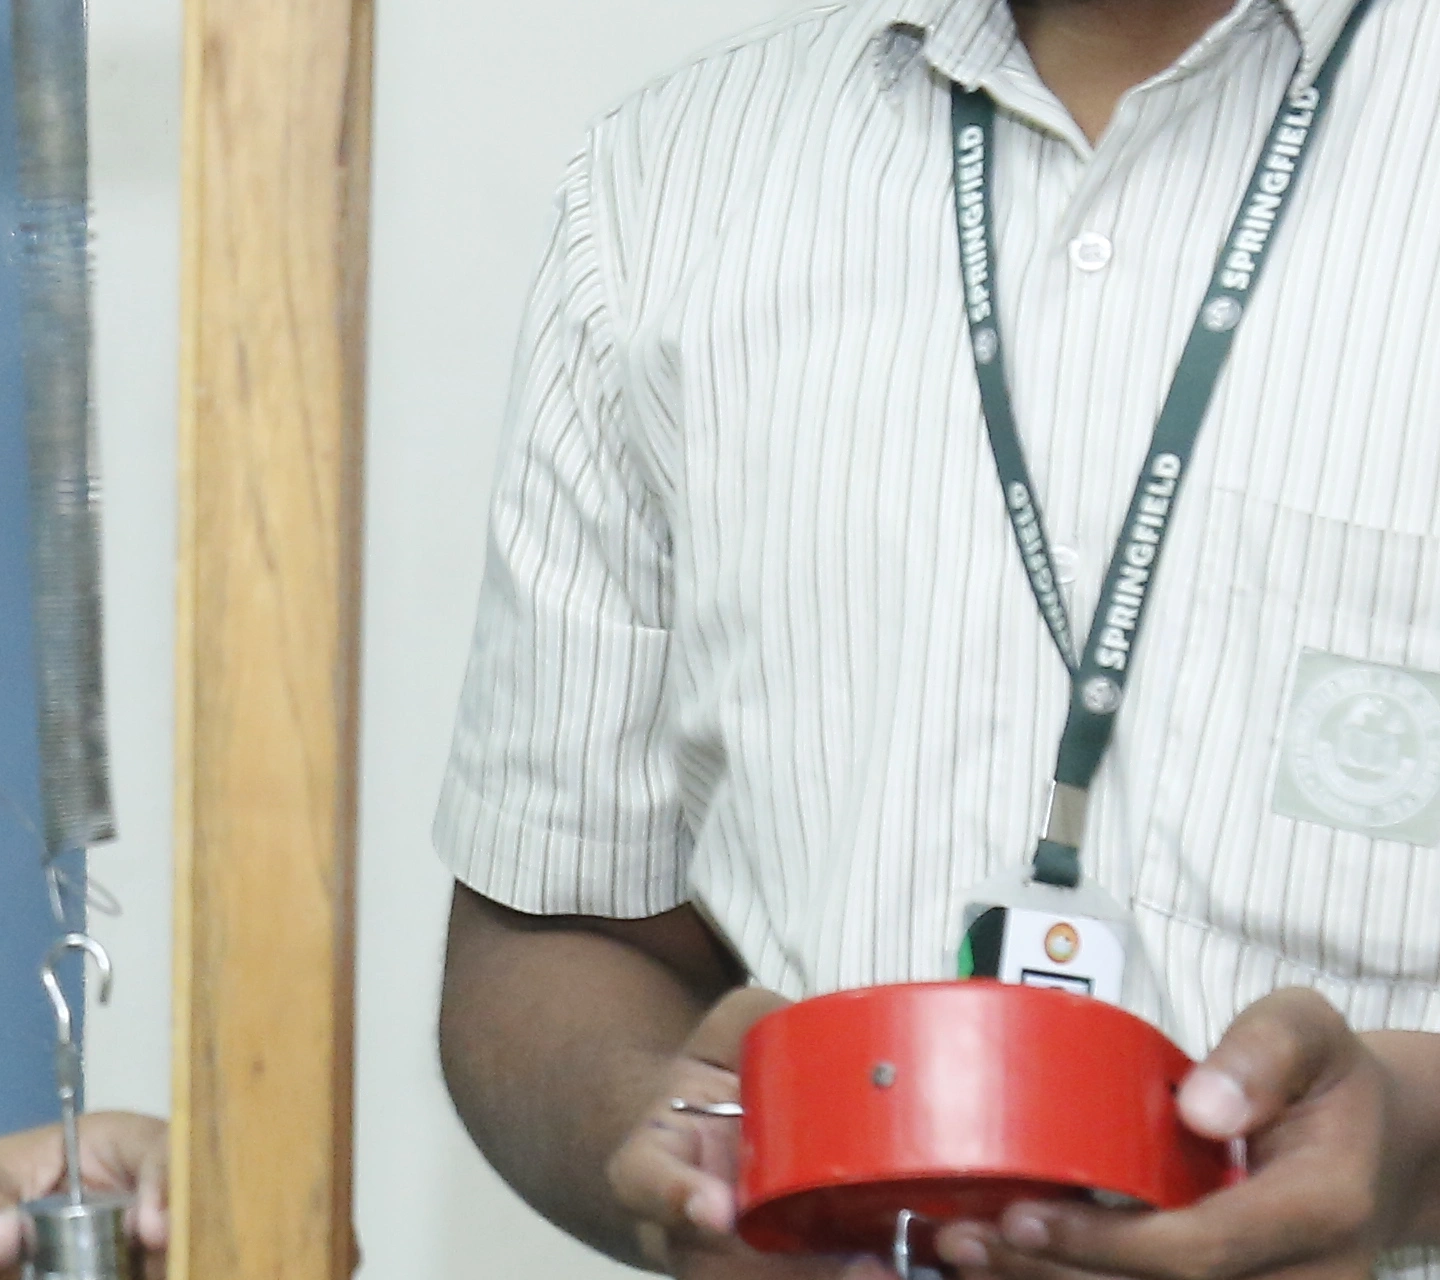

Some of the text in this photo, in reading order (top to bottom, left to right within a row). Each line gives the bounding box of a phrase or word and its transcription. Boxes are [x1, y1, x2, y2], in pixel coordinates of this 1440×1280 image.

[958, 125, 991, 324] SPRINGFIELD
[1221, 87, 1320, 290] SPRINGFIELD
[1095, 453, 1181, 670] SPRINGFIELD
